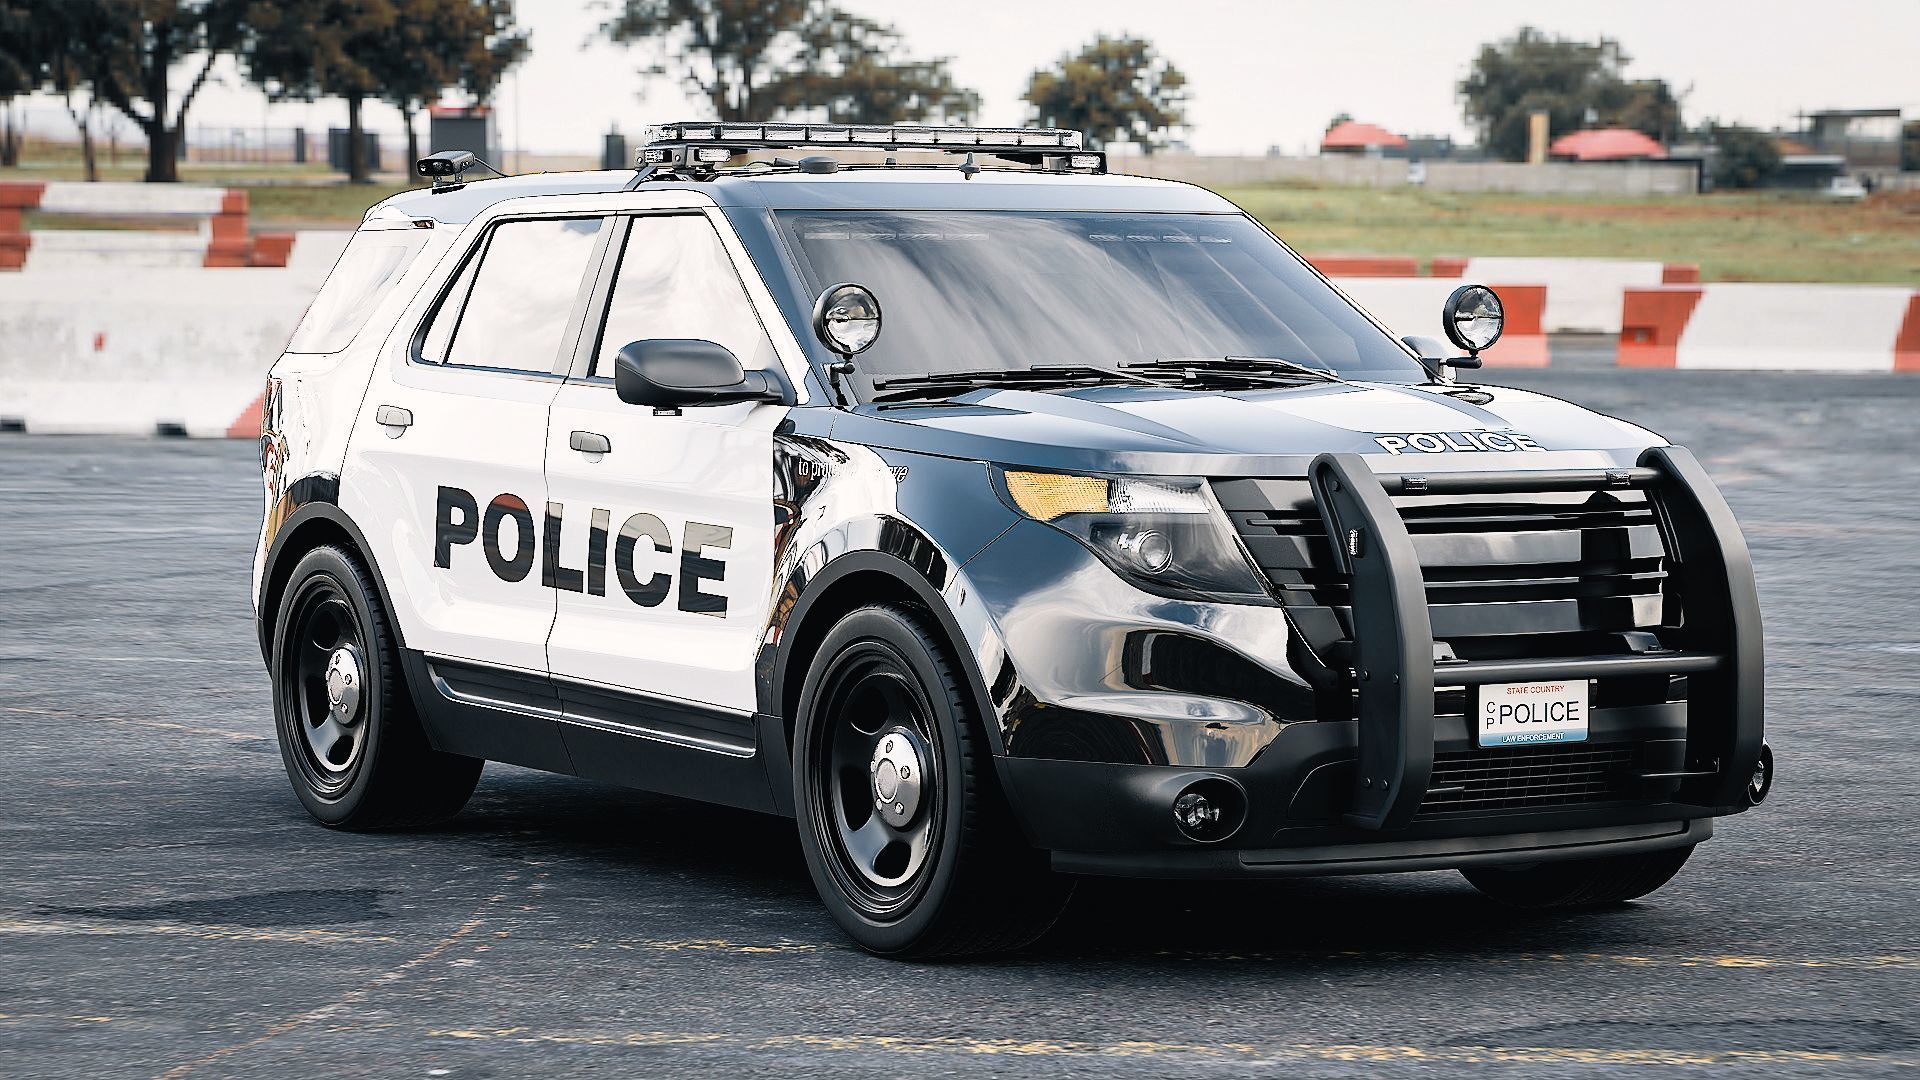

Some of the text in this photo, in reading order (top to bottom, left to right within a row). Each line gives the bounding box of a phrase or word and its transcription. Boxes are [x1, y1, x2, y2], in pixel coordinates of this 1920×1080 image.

[1373, 431, 1549, 456] POLICE
[798, 457, 809, 476] to
[434, 485, 733, 619] POLICE
[1506, 685, 1565, 695] STATE COUNTRY
[1500, 700, 1580, 725] POLICE
[1502, 732, 1565, 743] LAW ENFORCEMENT
